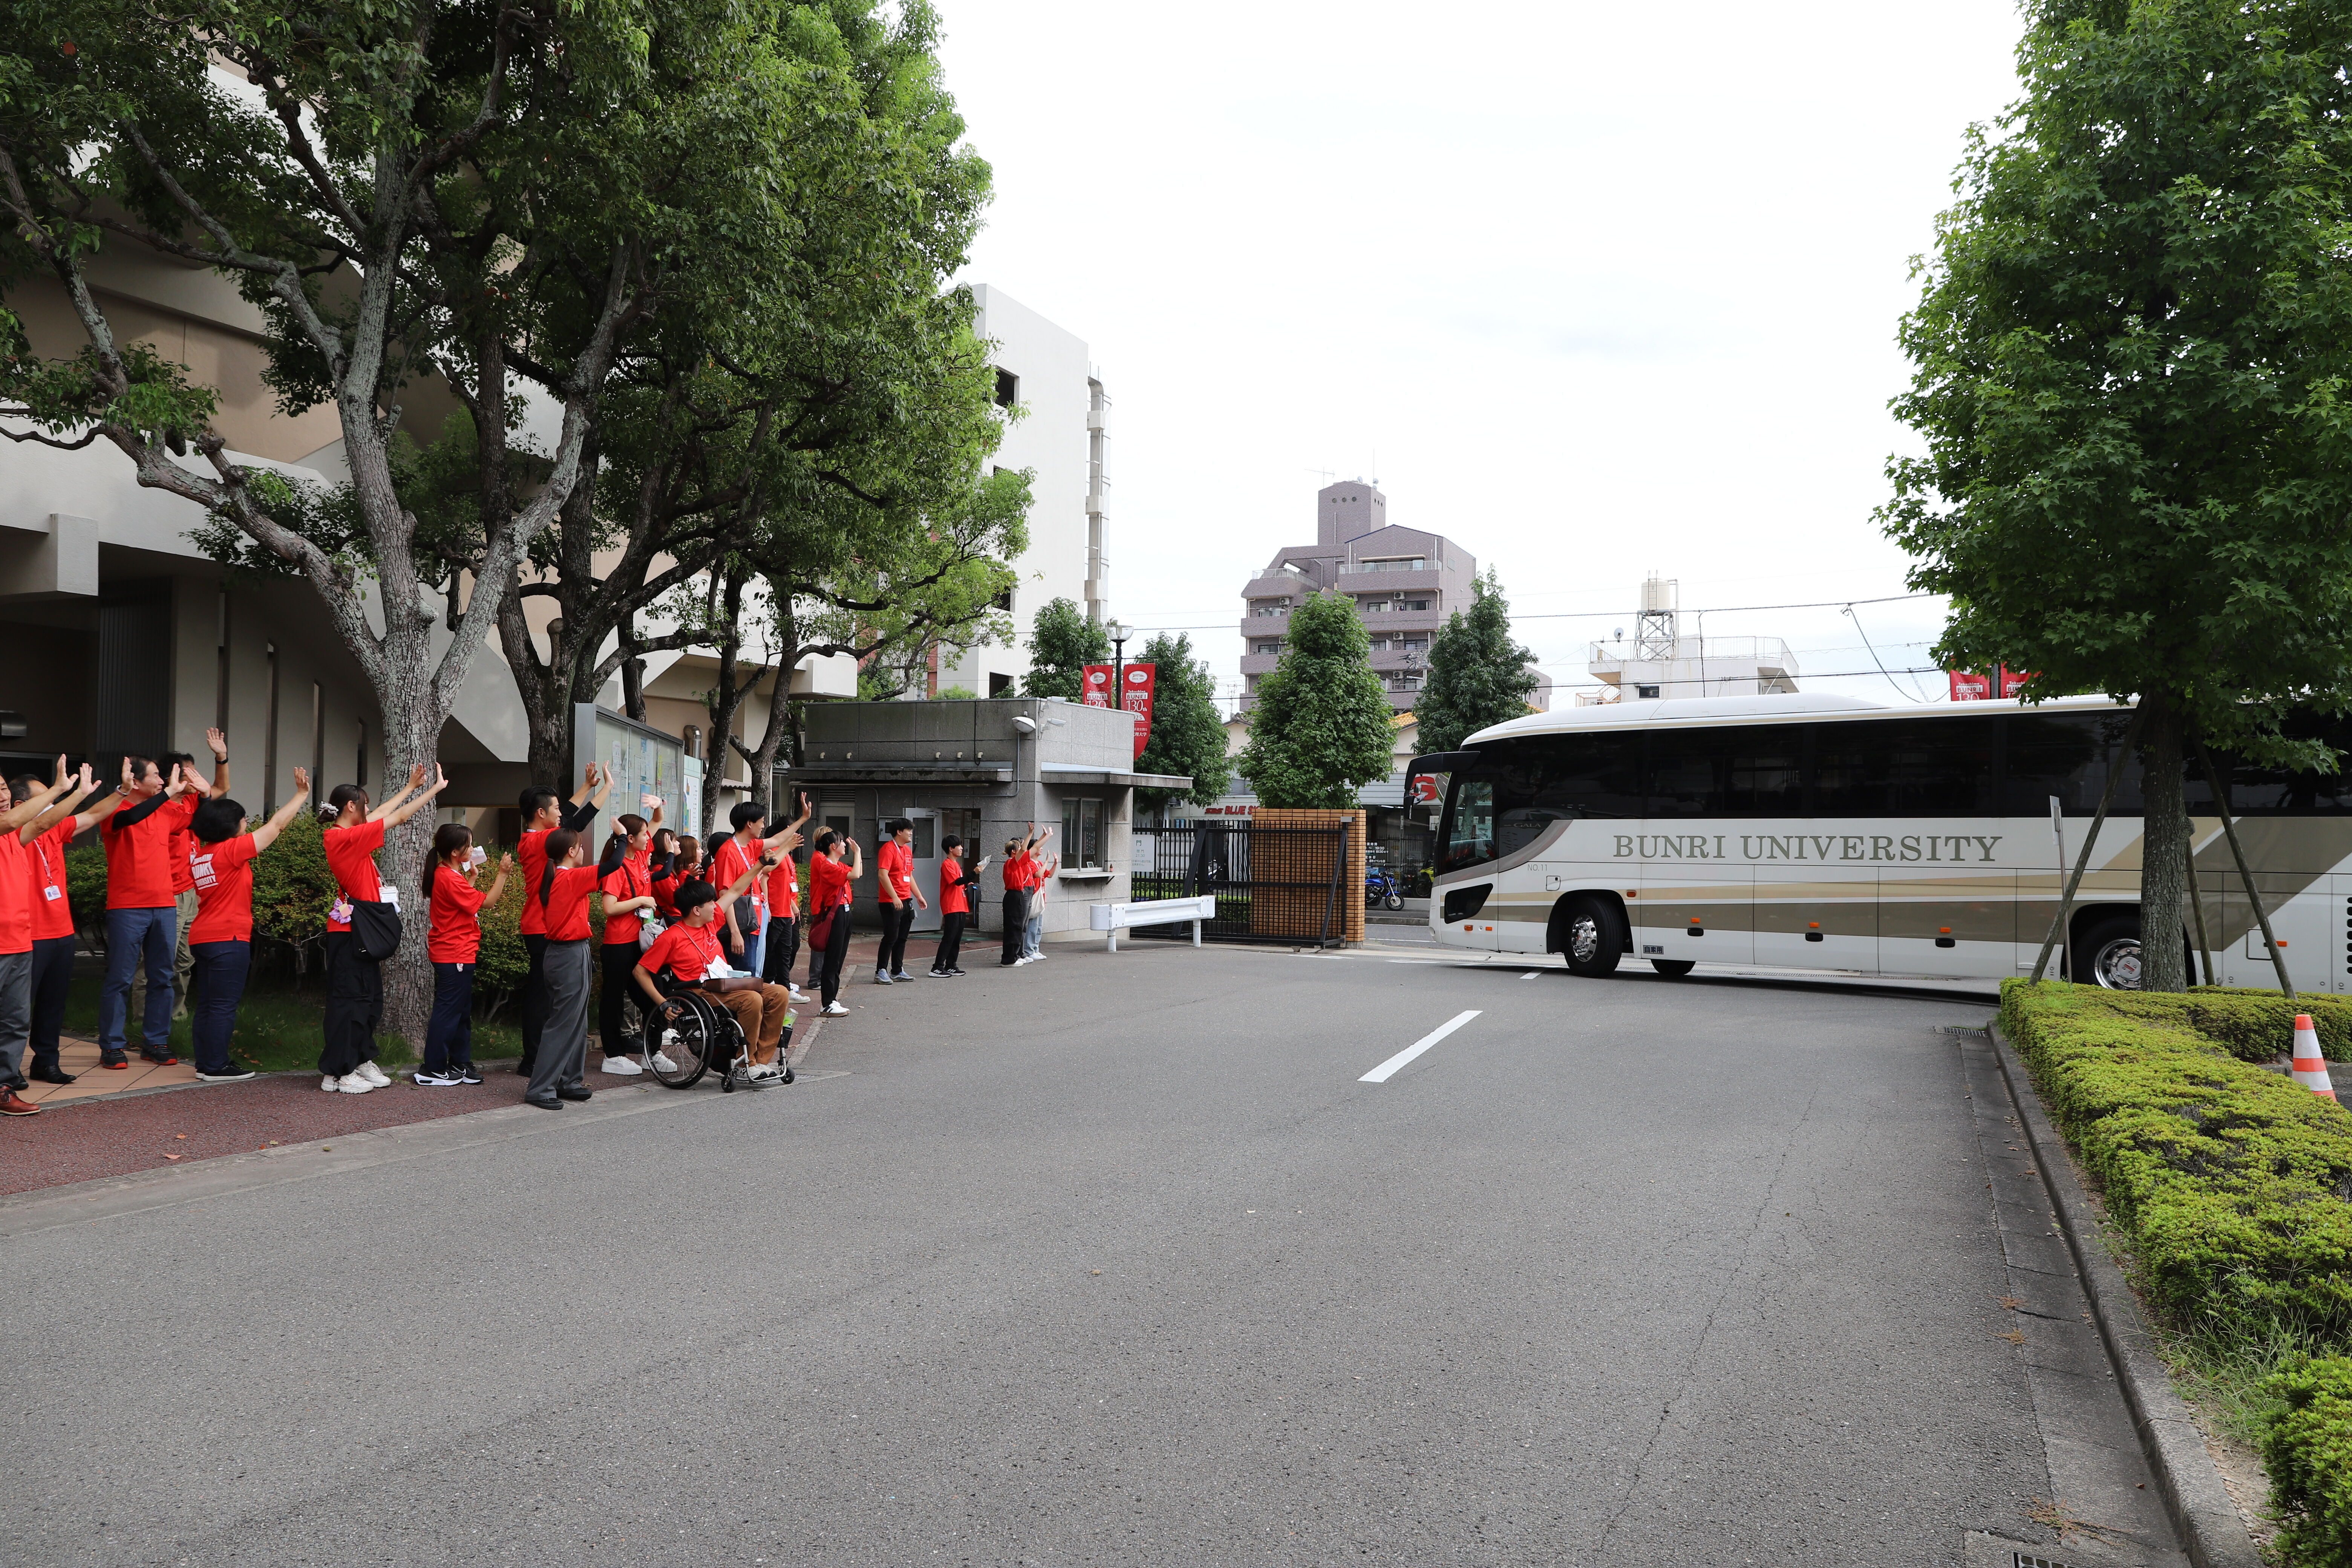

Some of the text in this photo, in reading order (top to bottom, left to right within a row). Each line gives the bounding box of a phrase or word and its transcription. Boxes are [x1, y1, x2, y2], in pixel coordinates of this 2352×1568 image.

[1225, 806, 1246, 815] BLUE
[1613, 835, 2003, 862] BUNRI UNIVERSITY
